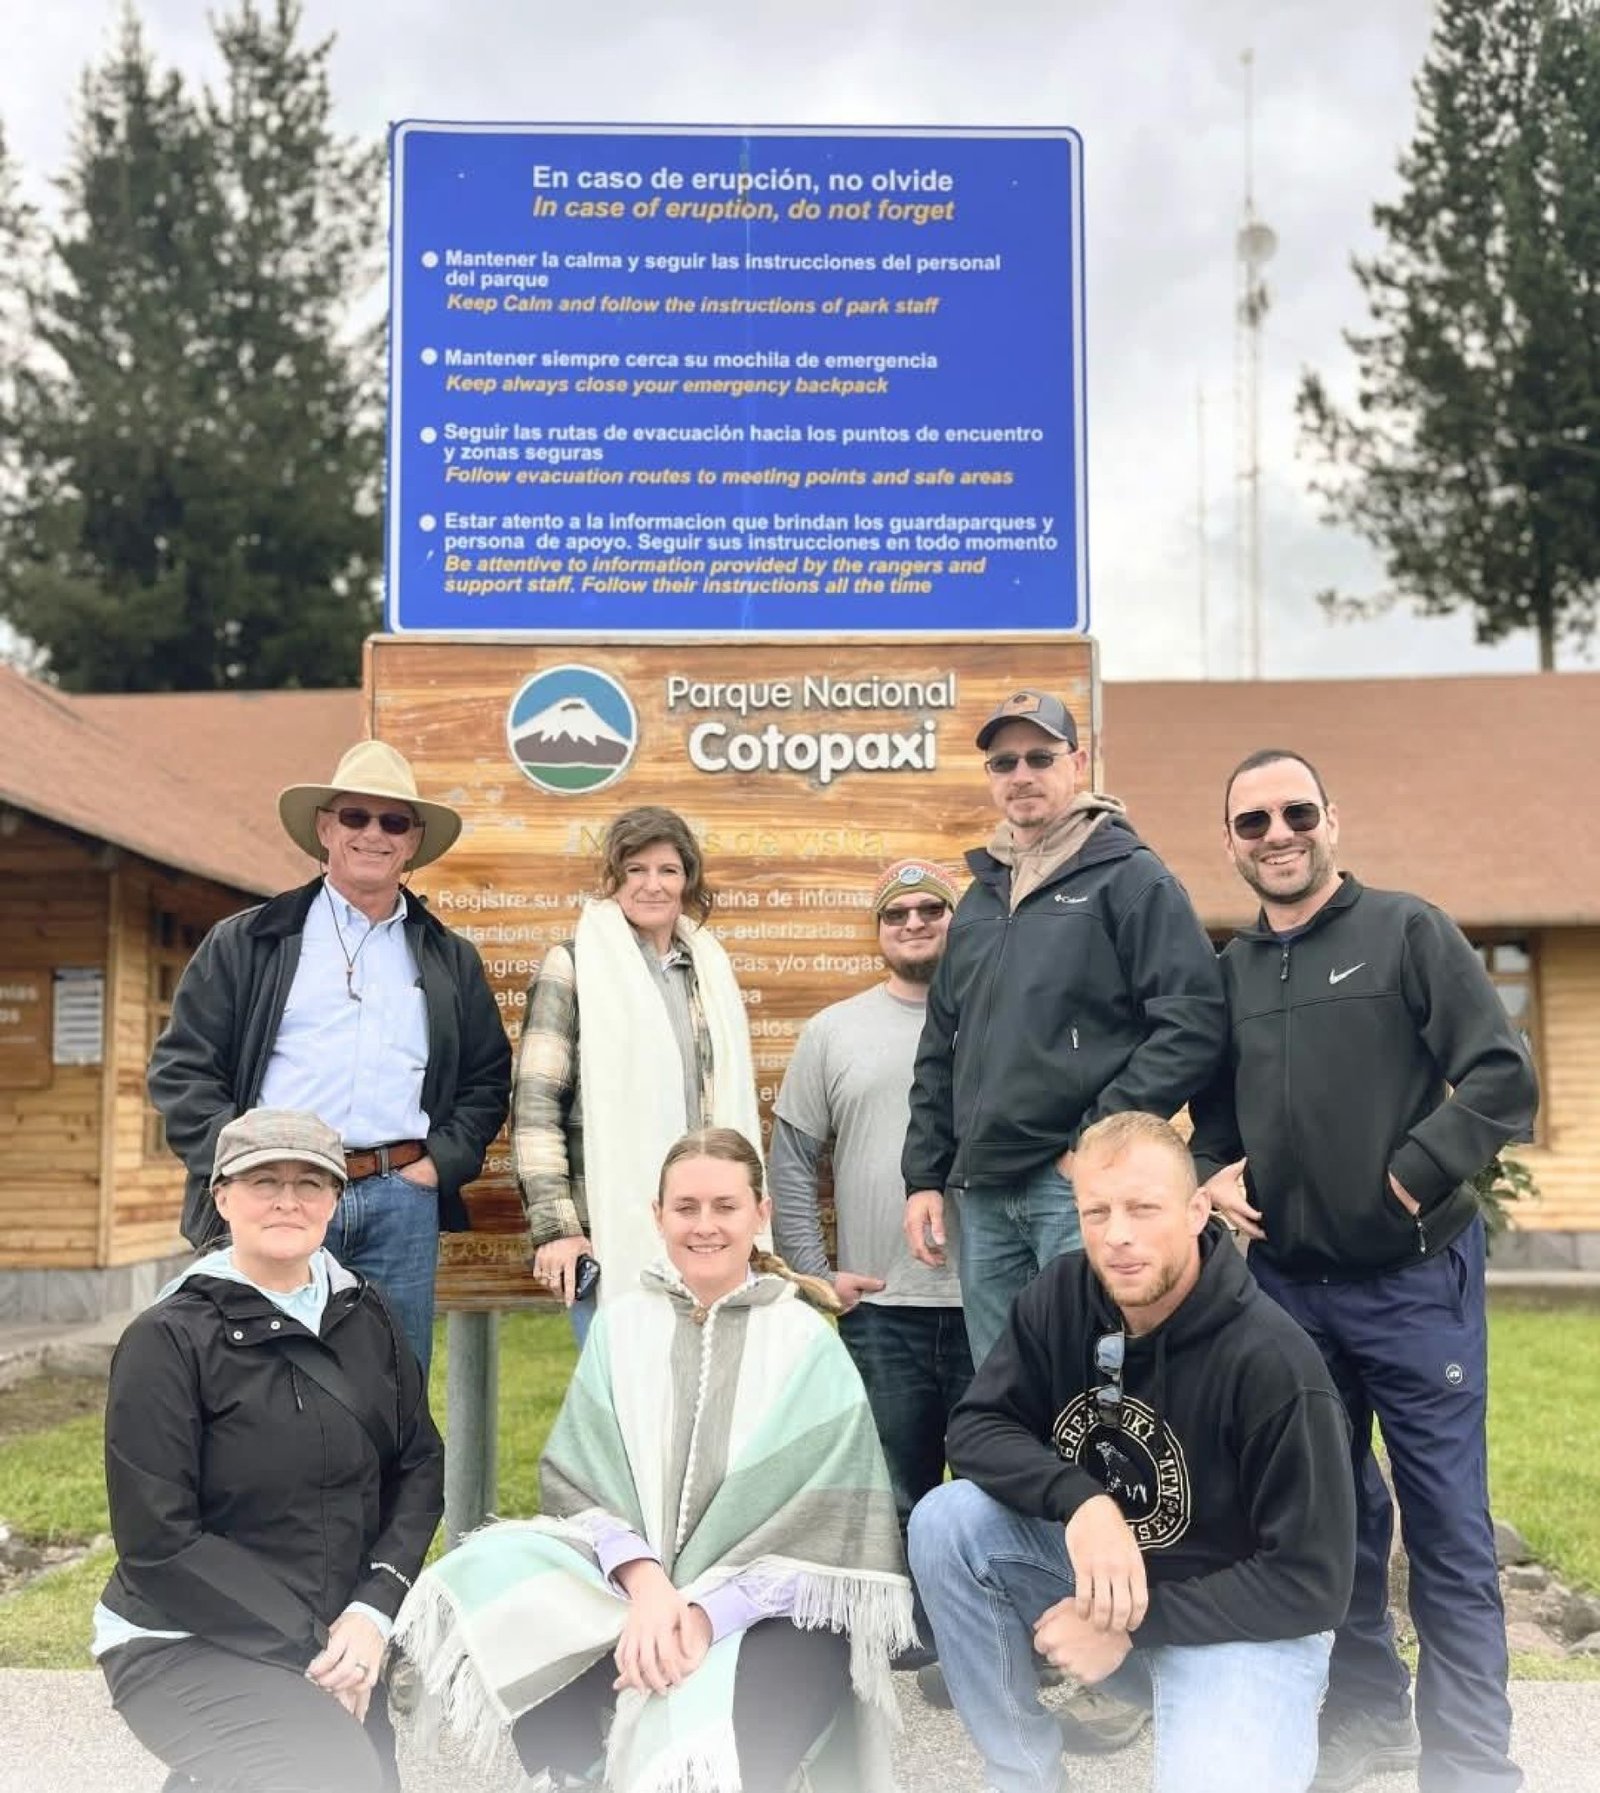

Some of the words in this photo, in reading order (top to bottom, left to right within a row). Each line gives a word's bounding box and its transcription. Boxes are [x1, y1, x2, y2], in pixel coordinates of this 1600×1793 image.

[532, 166, 569, 189] En
[576, 170, 643, 189] caso
[650, 167, 684, 190] de
[691, 166, 820, 197] erupción,
[828, 173, 864, 191] no
[871, 169, 954, 192] olvide
[532, 197, 558, 217] In
[564, 201, 626, 219] case
[631, 198, 662, 219] of
[665, 198, 779, 224] eruption,
[787, 199, 822, 220] do
[828, 200, 872, 220] not
[877, 200, 955, 226] forget
[445, 248, 537, 268] Mantener
[541, 250, 560, 268] la
[563, 251, 623, 269] calma
[627, 255, 640, 273] y
[644, 252, 707, 274] seguir
[711, 252, 740, 270] las
[744, 253, 877, 271] instrucciones
[881, 253, 912, 271] del
[916, 254, 1001, 275] personal
[444, 269, 475, 287] del
[480, 273, 549, 292] parque
[446, 293, 499, 315] Keep
[503, 295, 554, 313] Calm
[558, 295, 597, 312] and
[600, 295, 660, 313] follow
[664, 296, 696, 313] the
[700, 296, 816, 314] instructions
[821, 297, 843, 314] of
[845, 297, 889, 318] park
[895, 296, 940, 314] staff
[444, 348, 537, 367] Mantener
[541, 349, 620, 371] siempre
[624, 353, 680, 368] cerca
[683, 354, 708, 369] su
[713, 350, 791, 369] mochila
[795, 351, 820, 369] de
[824, 352, 938, 374] emergencia
[445, 374, 498, 395] Keep
[501, 375, 569, 396] always
[574, 376, 629, 393] close
[632, 379, 679, 397] your
[682, 379, 791, 397] emergency
[794, 376, 889, 397] backpack
[443, 422, 510, 445] Seguir
[513, 423, 543, 441] las
[547, 424, 599, 442] rutas
[603, 423, 628, 441] de
[632, 424, 745, 442] evacuación
[749, 424, 803, 442] hacia
[807, 425, 837, 443] los
[842, 426, 911, 446] puntos
[915, 425, 940, 442] de
[944, 426, 1044, 443] encuentro
[443, 446, 456, 464] y
[460, 446, 520, 461] zonas
[525, 446, 604, 465] seguras
[444, 465, 512, 484] Follow
[515, 467, 624, 485] evacuation
[627, 468, 692, 485] routes
[697, 468, 717, 485] to
[722, 467, 801, 489] meeting
[804, 468, 867, 488] points
[871, 468, 911, 486] and
[914, 467, 956, 485] safe
[959, 471, 1014, 485] areas
[444, 511, 498, 530] Estar
[501, 513, 565, 530] atento
[568, 516, 581, 530] a
[586, 512, 604, 530] la
[609, 511, 727, 531] informacion
[731, 516, 769, 535] que
[773, 513, 849, 531] brindan
[854, 513, 884, 531] los
[889, 513, 1037, 535] guardaparques
[1042, 517, 1054, 534] y
[444, 535, 525, 554] persona
[535, 532, 561, 550] de
[565, 535, 632, 554] apoyo.
[637, 533, 703, 554] Seguir
[706, 536, 743, 551] sus
[748, 533, 881, 551] instrucciones
[885, 537, 911, 551] en
[915, 533, 961, 551] todo
[965, 534, 1058, 551] momento
[444, 555, 472, 572] Be
[476, 555, 563, 573] attentive
[567, 557, 588, 574] to
[592, 556, 706, 574] information
[709, 556, 799, 577] provided
[802, 556, 828, 577] by
[832, 556, 864, 574] the
[867, 560, 944, 578] rangers
[948, 556, 987, 574] and
[444, 576, 523, 596] support
[527, 575, 575, 593] staff.
[581, 575, 648, 594] Follow
[652, 576, 699, 594] their
[702, 576, 820, 594] instructions
[824, 576, 850, 594] all
[853, 576, 885, 594] the
[889, 575, 932, 594] time
[667, 675, 793, 716] Parque
[802, 673, 956, 708] Nacional
[688, 719, 937, 784] Cotopaxi
[438, 889, 528, 913] Registre
[534, 893, 559, 908] su
[766, 889, 793, 907] de
[454, 923, 543, 941] stacione
[734, 921, 856, 940] autorizadas
[483, 958, 541, 978] ngres
[775, 954, 807, 975] y/o
[812, 954, 885, 976] drogas
